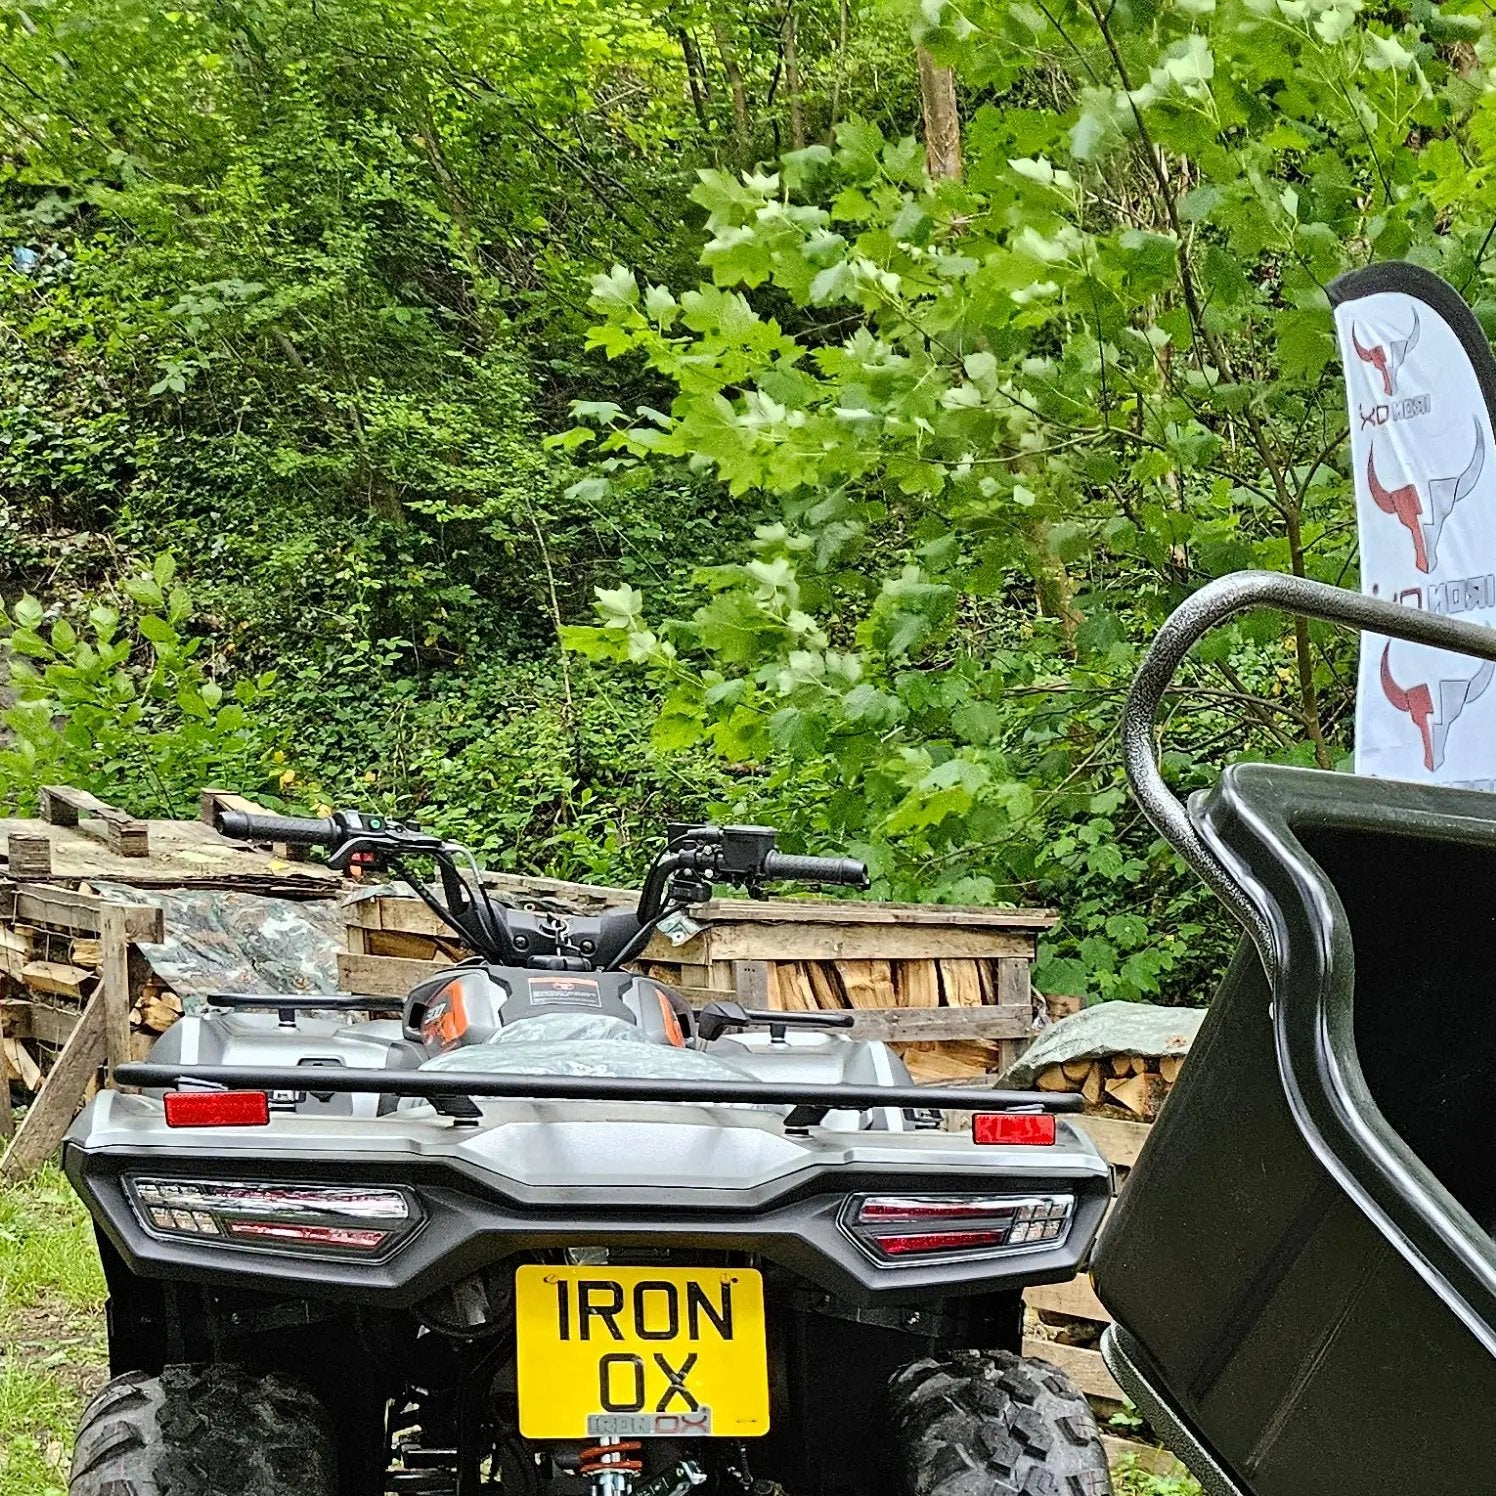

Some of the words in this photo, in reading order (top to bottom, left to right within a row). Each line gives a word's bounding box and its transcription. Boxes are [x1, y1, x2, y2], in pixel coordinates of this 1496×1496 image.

[557, 1280, 733, 1340] IRON
[599, 1353, 702, 1412] OX
[588, 1415, 651, 1435] IRON
[655, 1415, 707, 1434] OX
